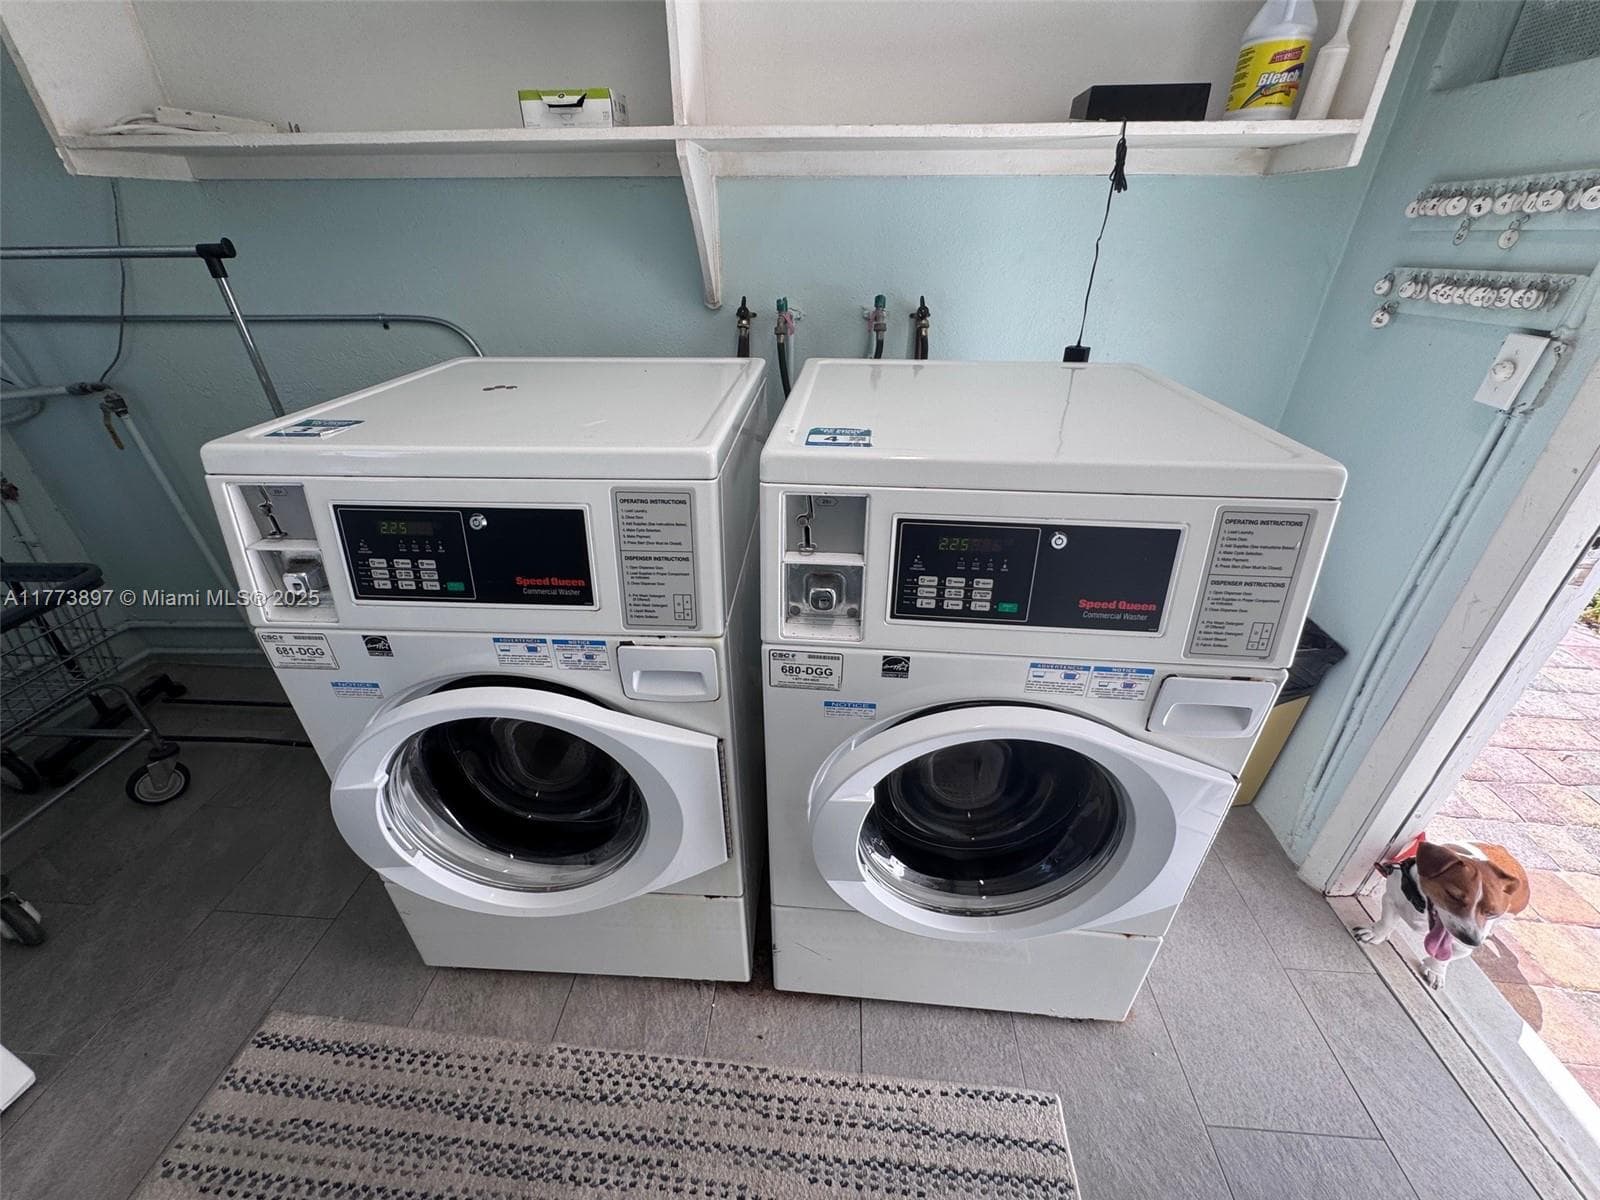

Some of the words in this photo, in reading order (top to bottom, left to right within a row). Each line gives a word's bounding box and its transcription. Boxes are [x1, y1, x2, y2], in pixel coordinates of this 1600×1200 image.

[1258, 70, 1300, 88] Bleach
[939, 538, 968, 551] 2.25
[516, 576, 549, 586] Speed
[551, 577, 585, 586] Queen
[1078, 599, 1116, 610] Speed
[1118, 600, 1156, 611] Queen
[1083, 611, 1120, 619] Commercial
[276, 647, 325, 656] 681-DGG
[781, 665, 833, 676] 680-DGG
